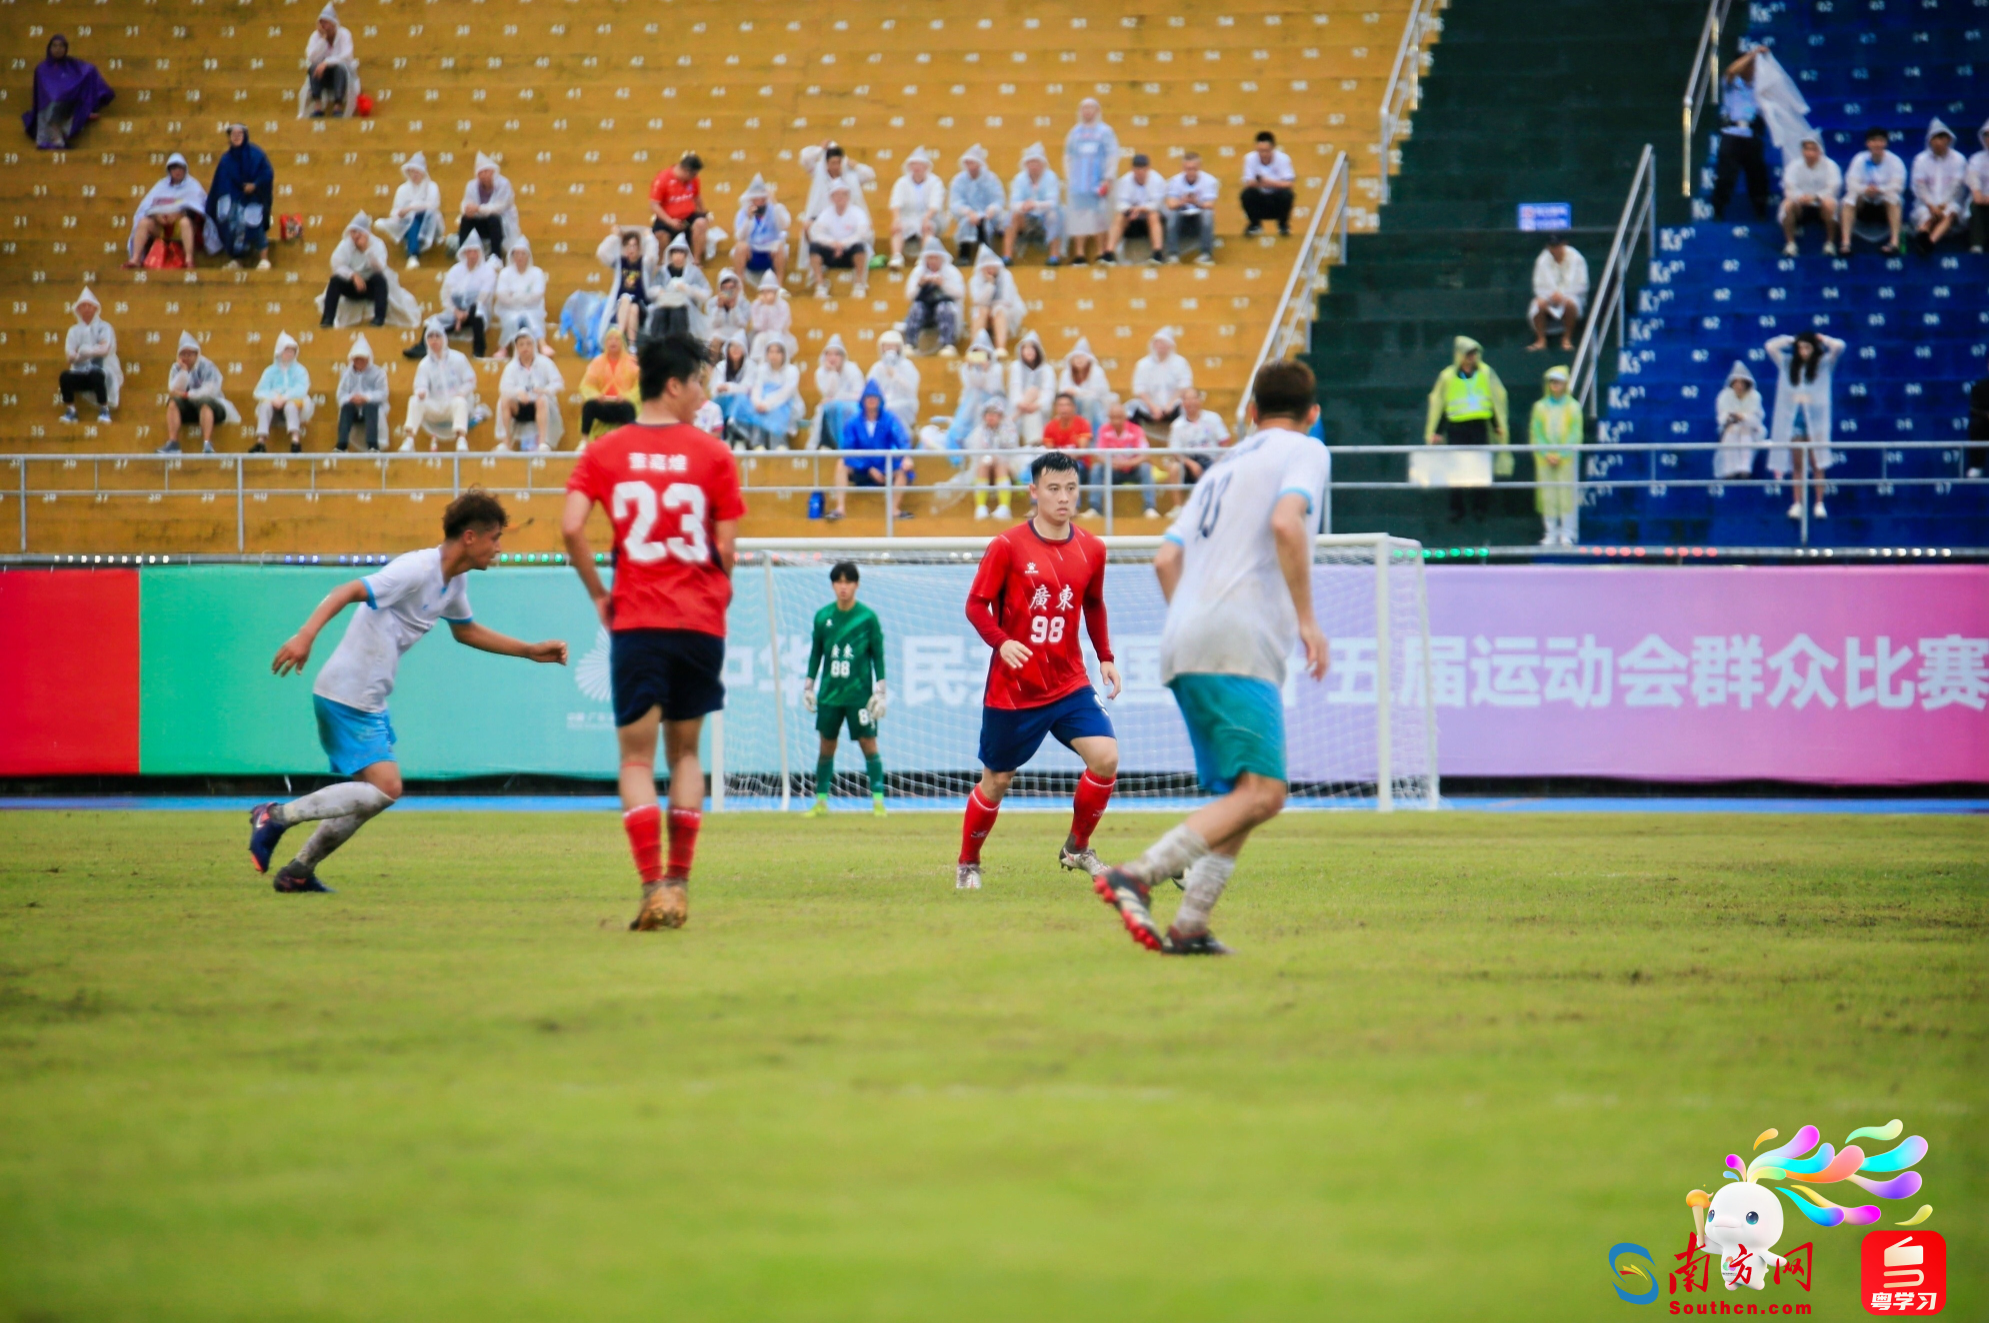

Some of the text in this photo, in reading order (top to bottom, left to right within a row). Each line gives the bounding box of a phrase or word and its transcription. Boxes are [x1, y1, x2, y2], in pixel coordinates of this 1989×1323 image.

[234, 271, 249, 284] 37
[197, 331, 212, 343] 37
[611, 479, 709, 563] 23
[1029, 583, 1075, 612] 廣東
[1030, 614, 1066, 645] 98
[830, 659, 851, 679] 88
